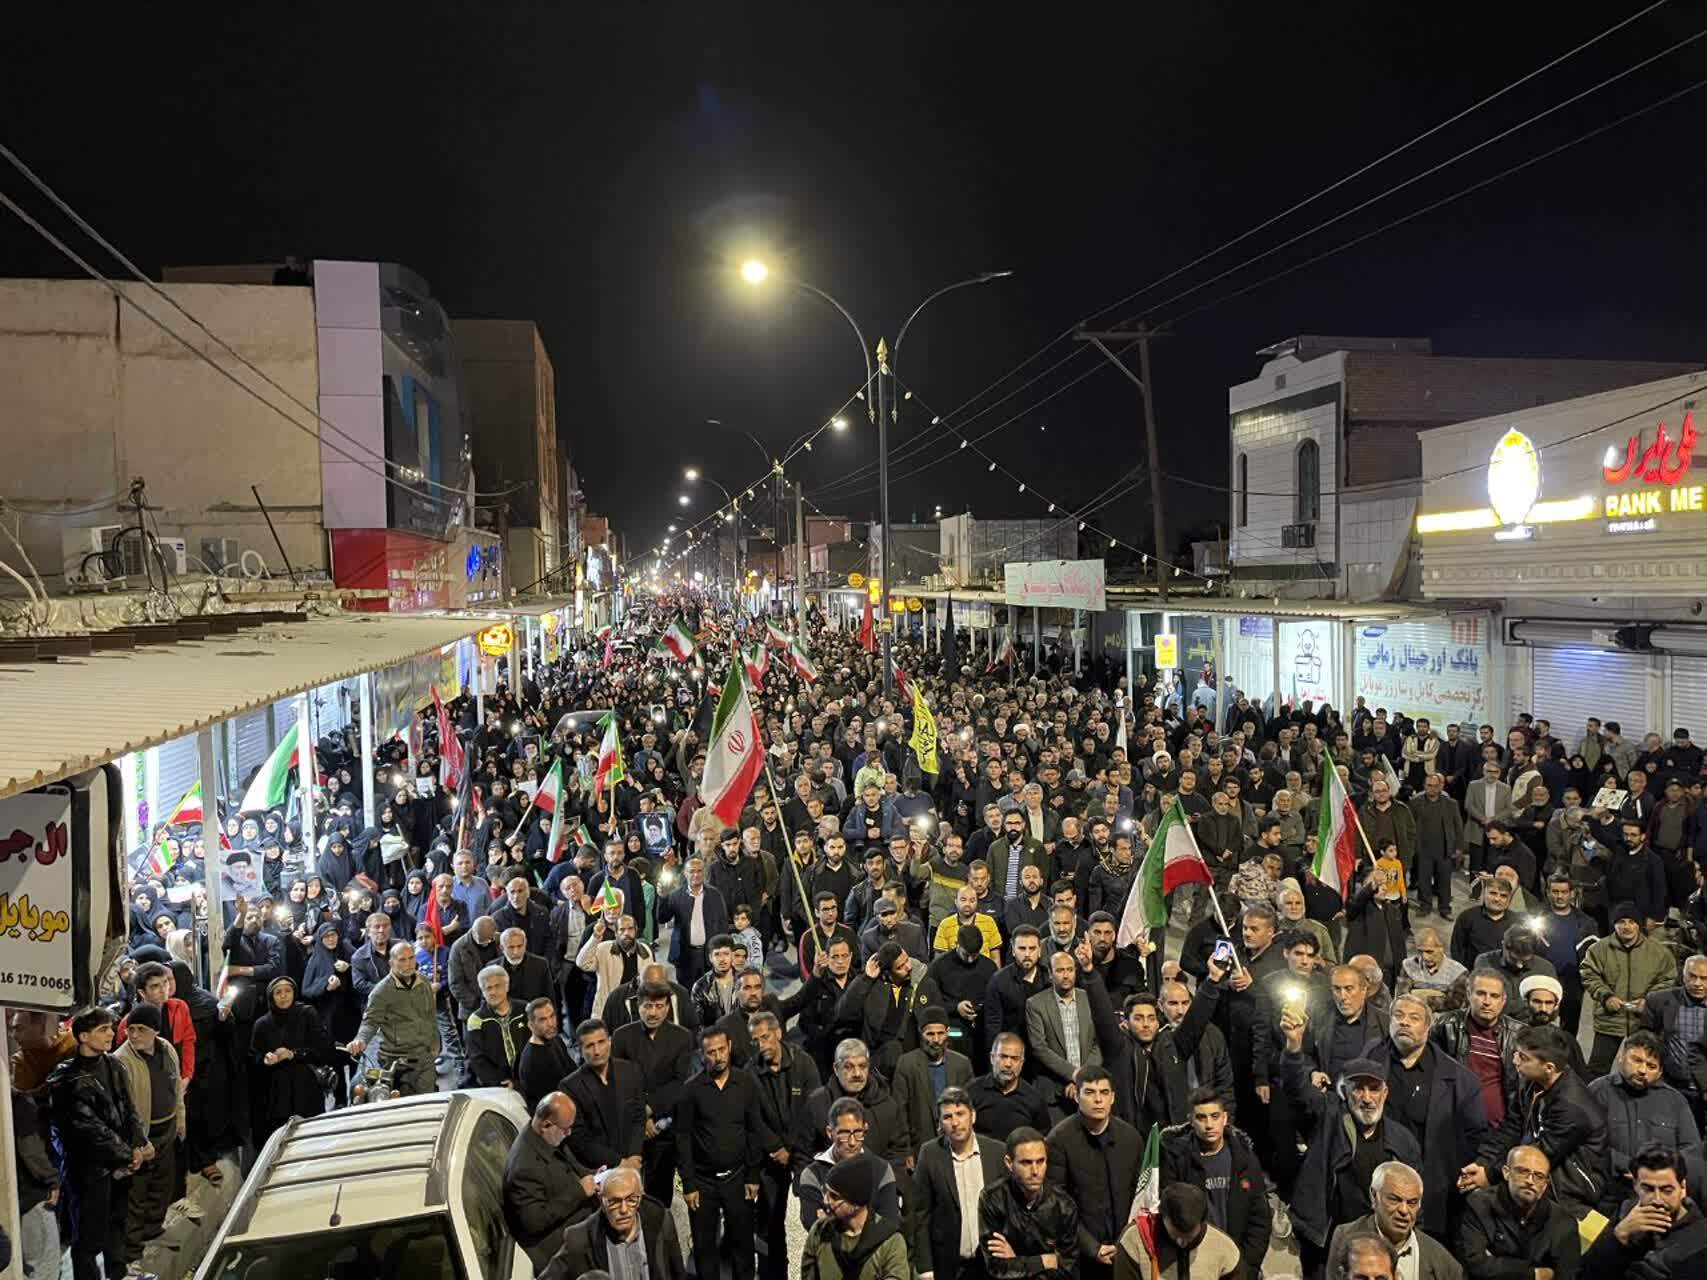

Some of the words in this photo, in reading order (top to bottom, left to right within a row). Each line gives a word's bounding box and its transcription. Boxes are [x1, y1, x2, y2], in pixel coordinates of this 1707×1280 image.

[1606, 492, 1662, 516] BANK
[1670, 486, 1703, 512] ME
[1450, 647, 1478, 676] بانک
[17, 973, 38, 986] 172
[40, 975, 71, 990] 0065
